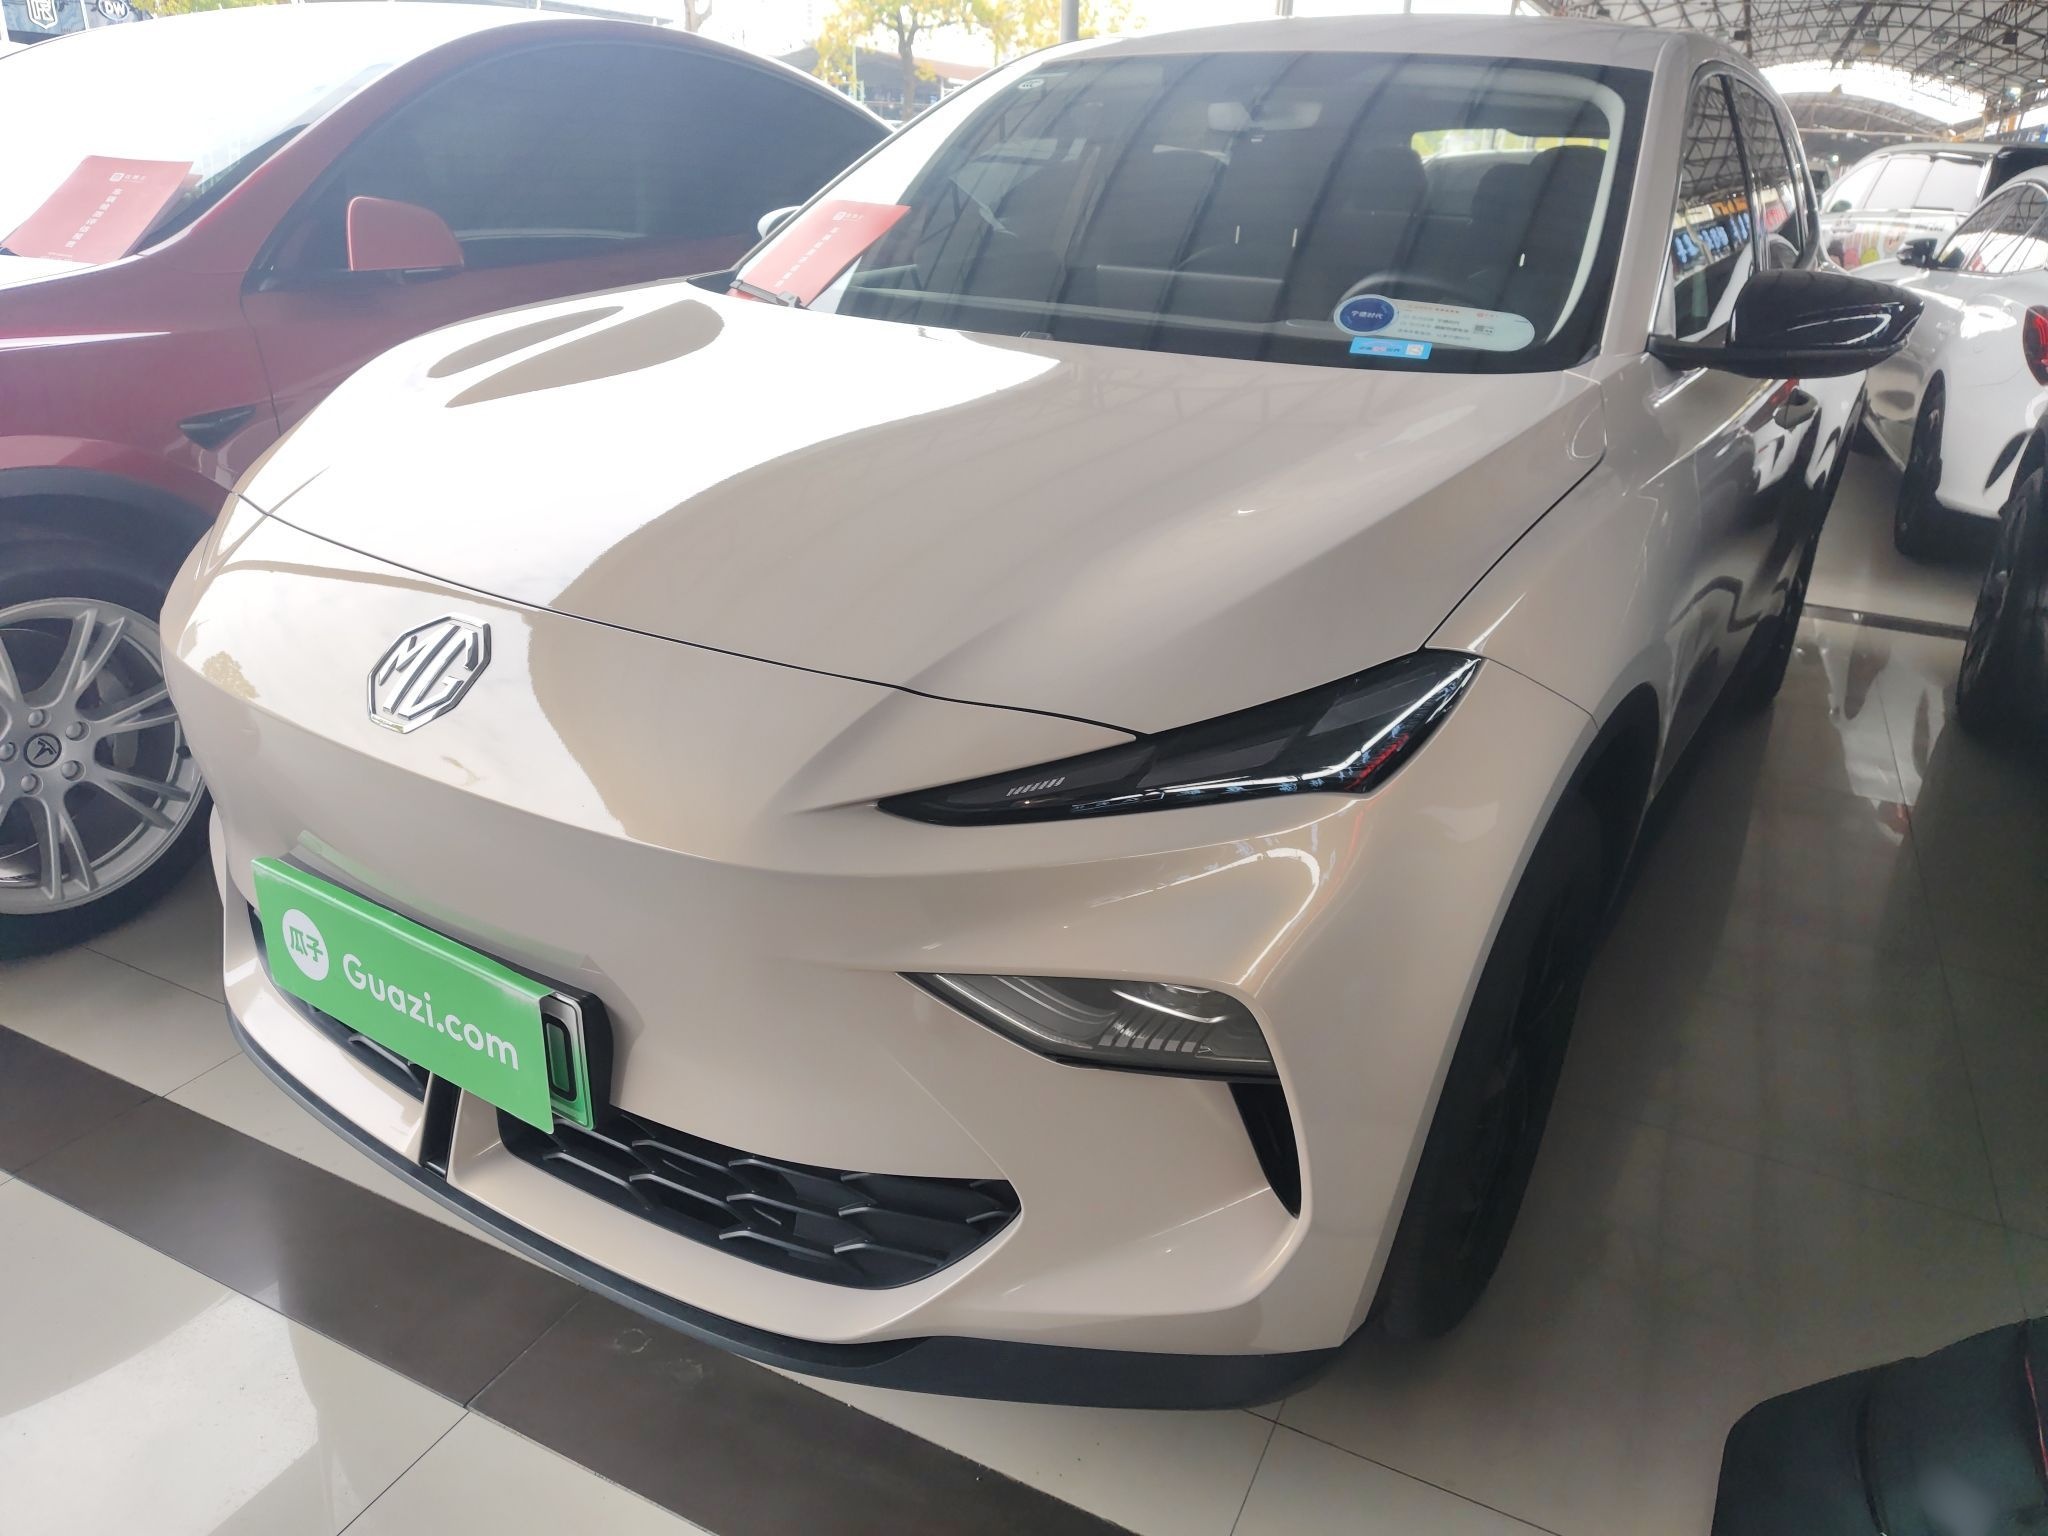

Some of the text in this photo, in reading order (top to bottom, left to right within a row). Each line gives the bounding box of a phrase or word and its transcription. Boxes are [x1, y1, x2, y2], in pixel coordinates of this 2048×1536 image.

[379, 623, 479, 720] MG
[287, 925, 325, 962] 瓜子
[342, 953, 520, 1071] Guazi.com
